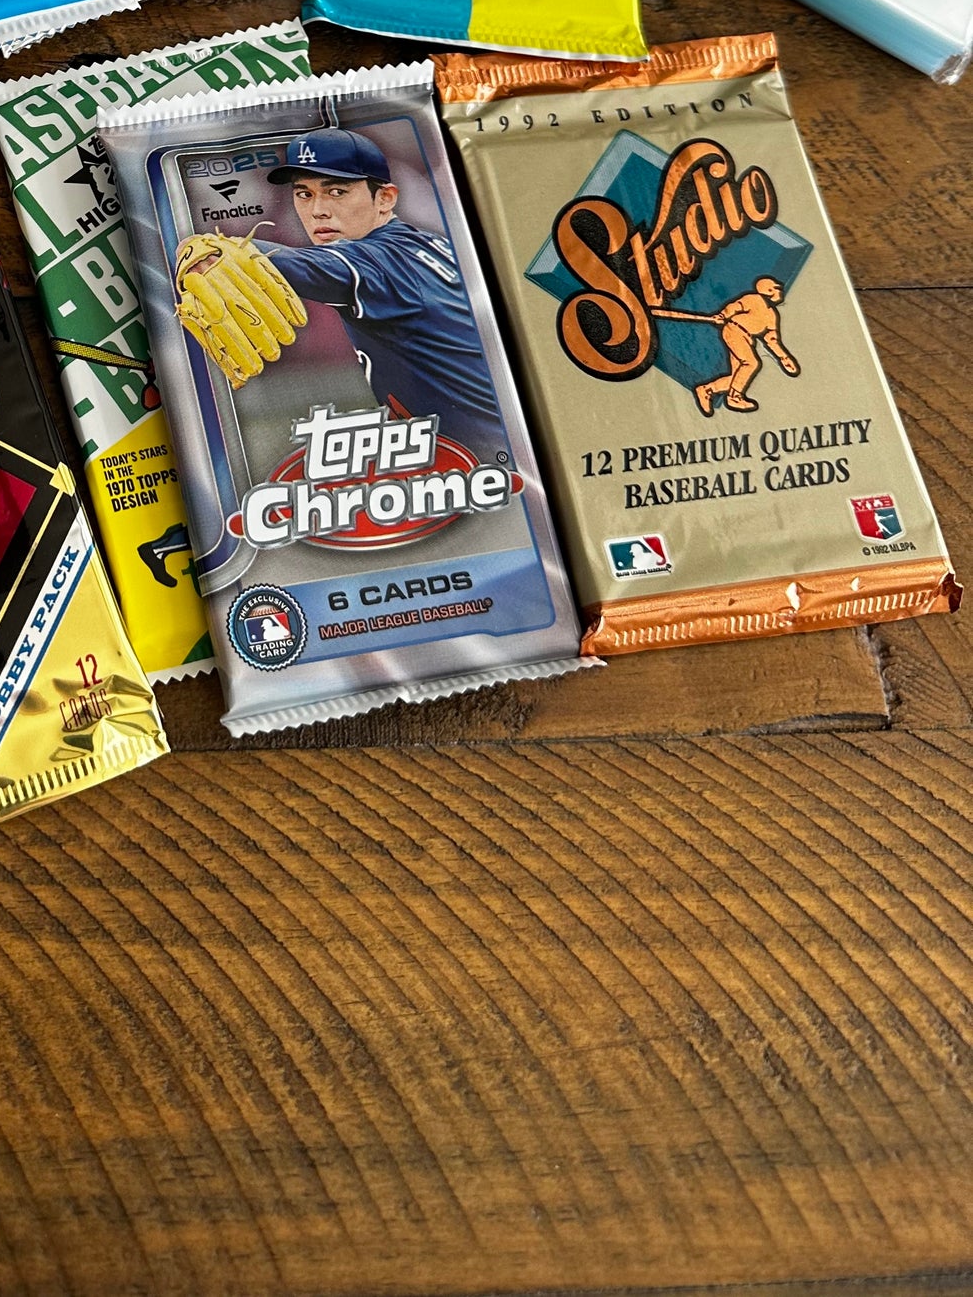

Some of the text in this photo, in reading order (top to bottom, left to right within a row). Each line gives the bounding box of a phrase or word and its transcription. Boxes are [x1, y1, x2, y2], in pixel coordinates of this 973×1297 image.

[476, 92, 755, 132] 1992 EDITION
[184, 151, 279, 178] 2025
[201, 204, 264, 222] Fanatics
[552, 138, 778, 381] Studio
[100, 445, 168, 469] TODAY'S STARS
[581, 419, 871, 478] 12 PREMIUM QUALITY
[104, 465, 133, 481] IN THE
[106, 469, 177, 498] 1970 TOPPS
[624, 458, 850, 509] BASEBALL CARDS
[111, 489, 159, 512] DESIGN
[242, 465, 512, 548] Chrome
[31, 547, 80, 632] PACK
[244, 596, 291, 614] EXCLUSIVE
[328, 571, 473, 611] 6 CARDS
[249, 639, 294, 654] TRADING
[259, 648, 287, 659] CARD
[75, 654, 103, 688] 12
[59, 688, 112, 731] CARDS
